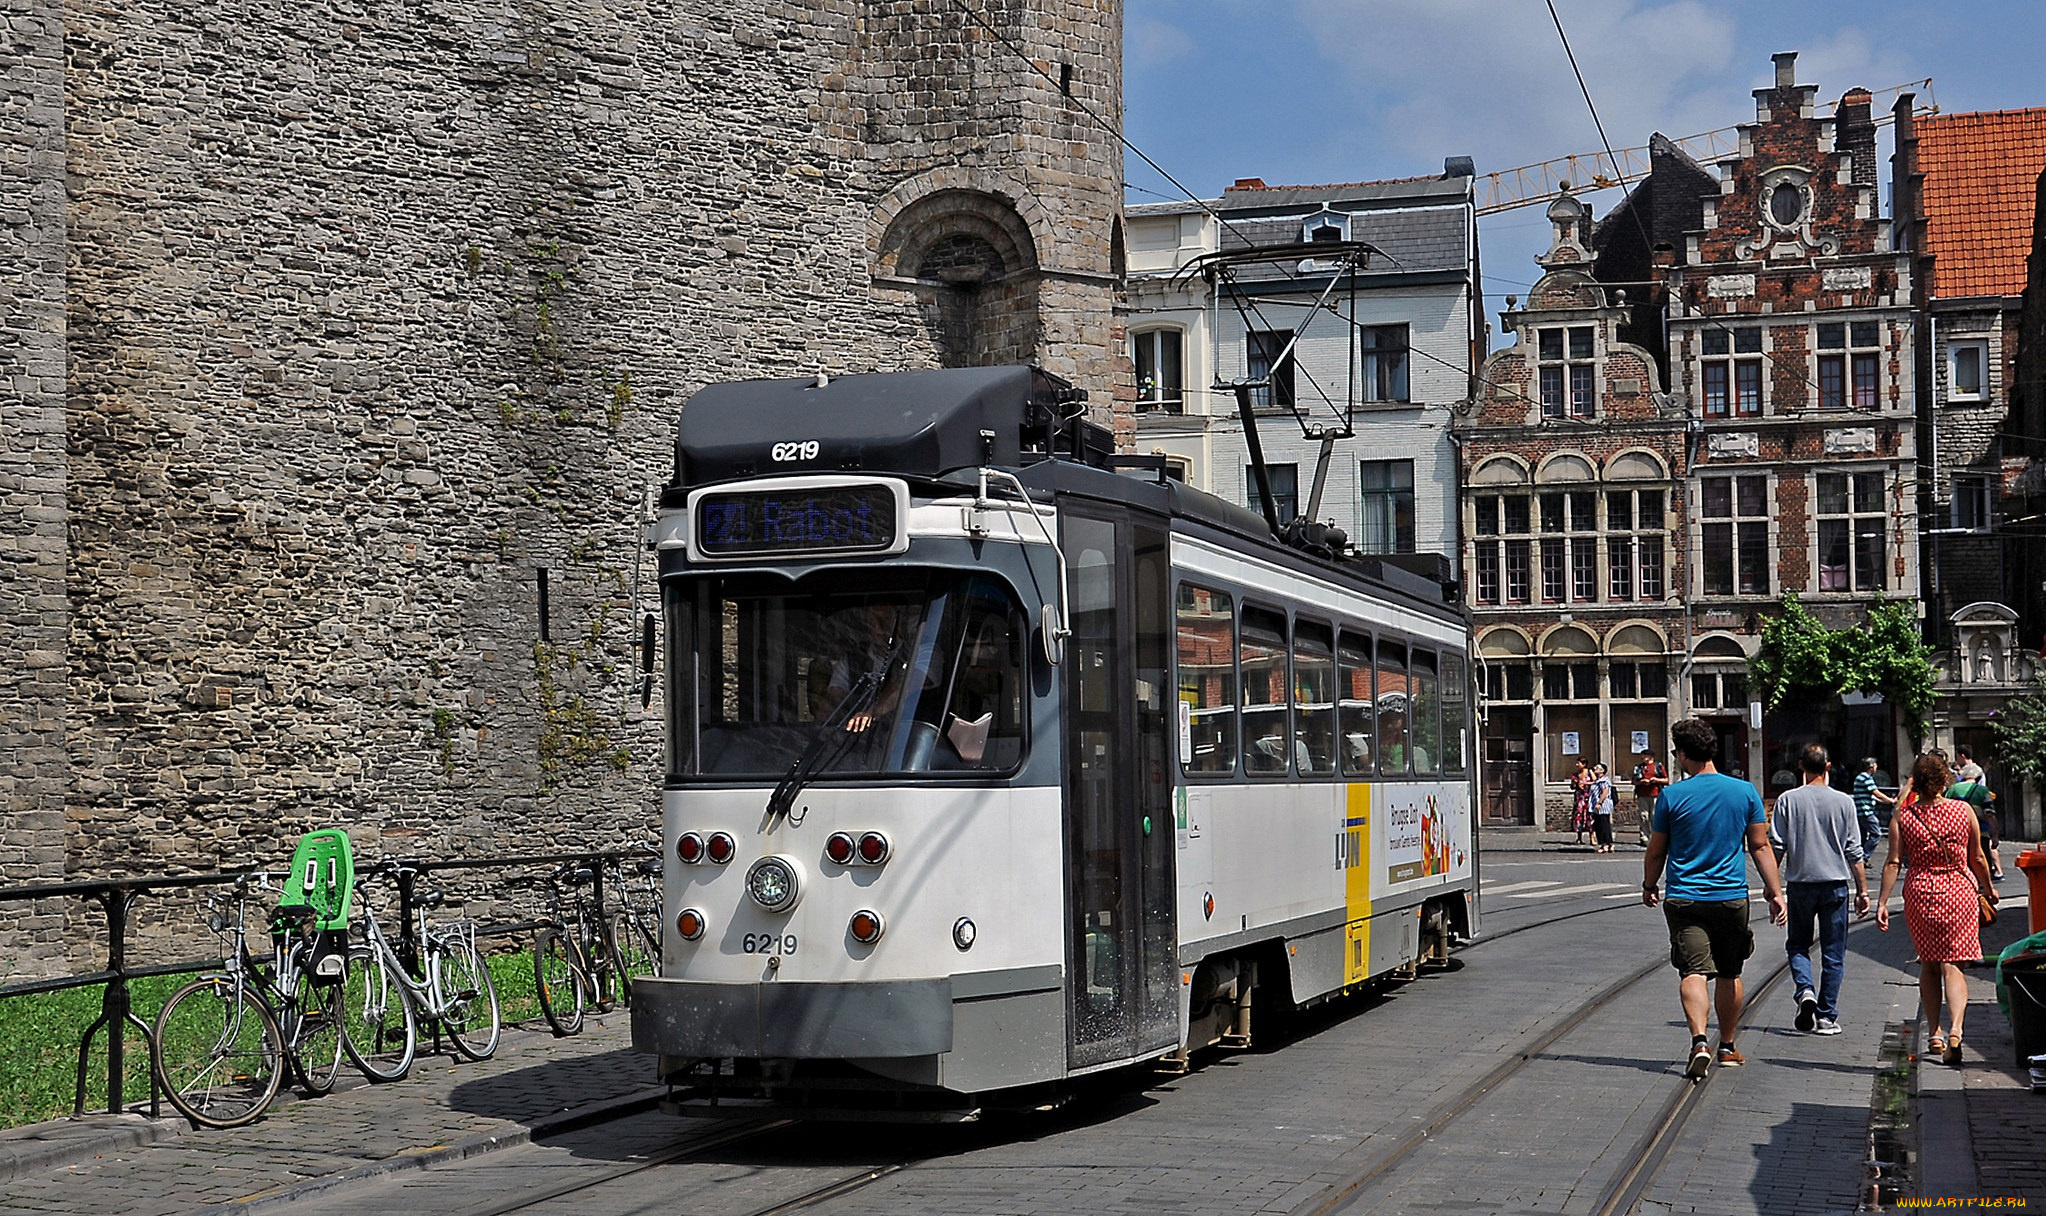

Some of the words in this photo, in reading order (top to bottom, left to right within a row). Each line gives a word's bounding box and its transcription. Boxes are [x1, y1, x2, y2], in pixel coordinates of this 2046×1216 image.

[771, 440, 820, 462] 6219
[763, 497, 872, 543] Rabot
[1702, 614, 1738, 626] PALM
[743, 932, 798, 955] 6219
